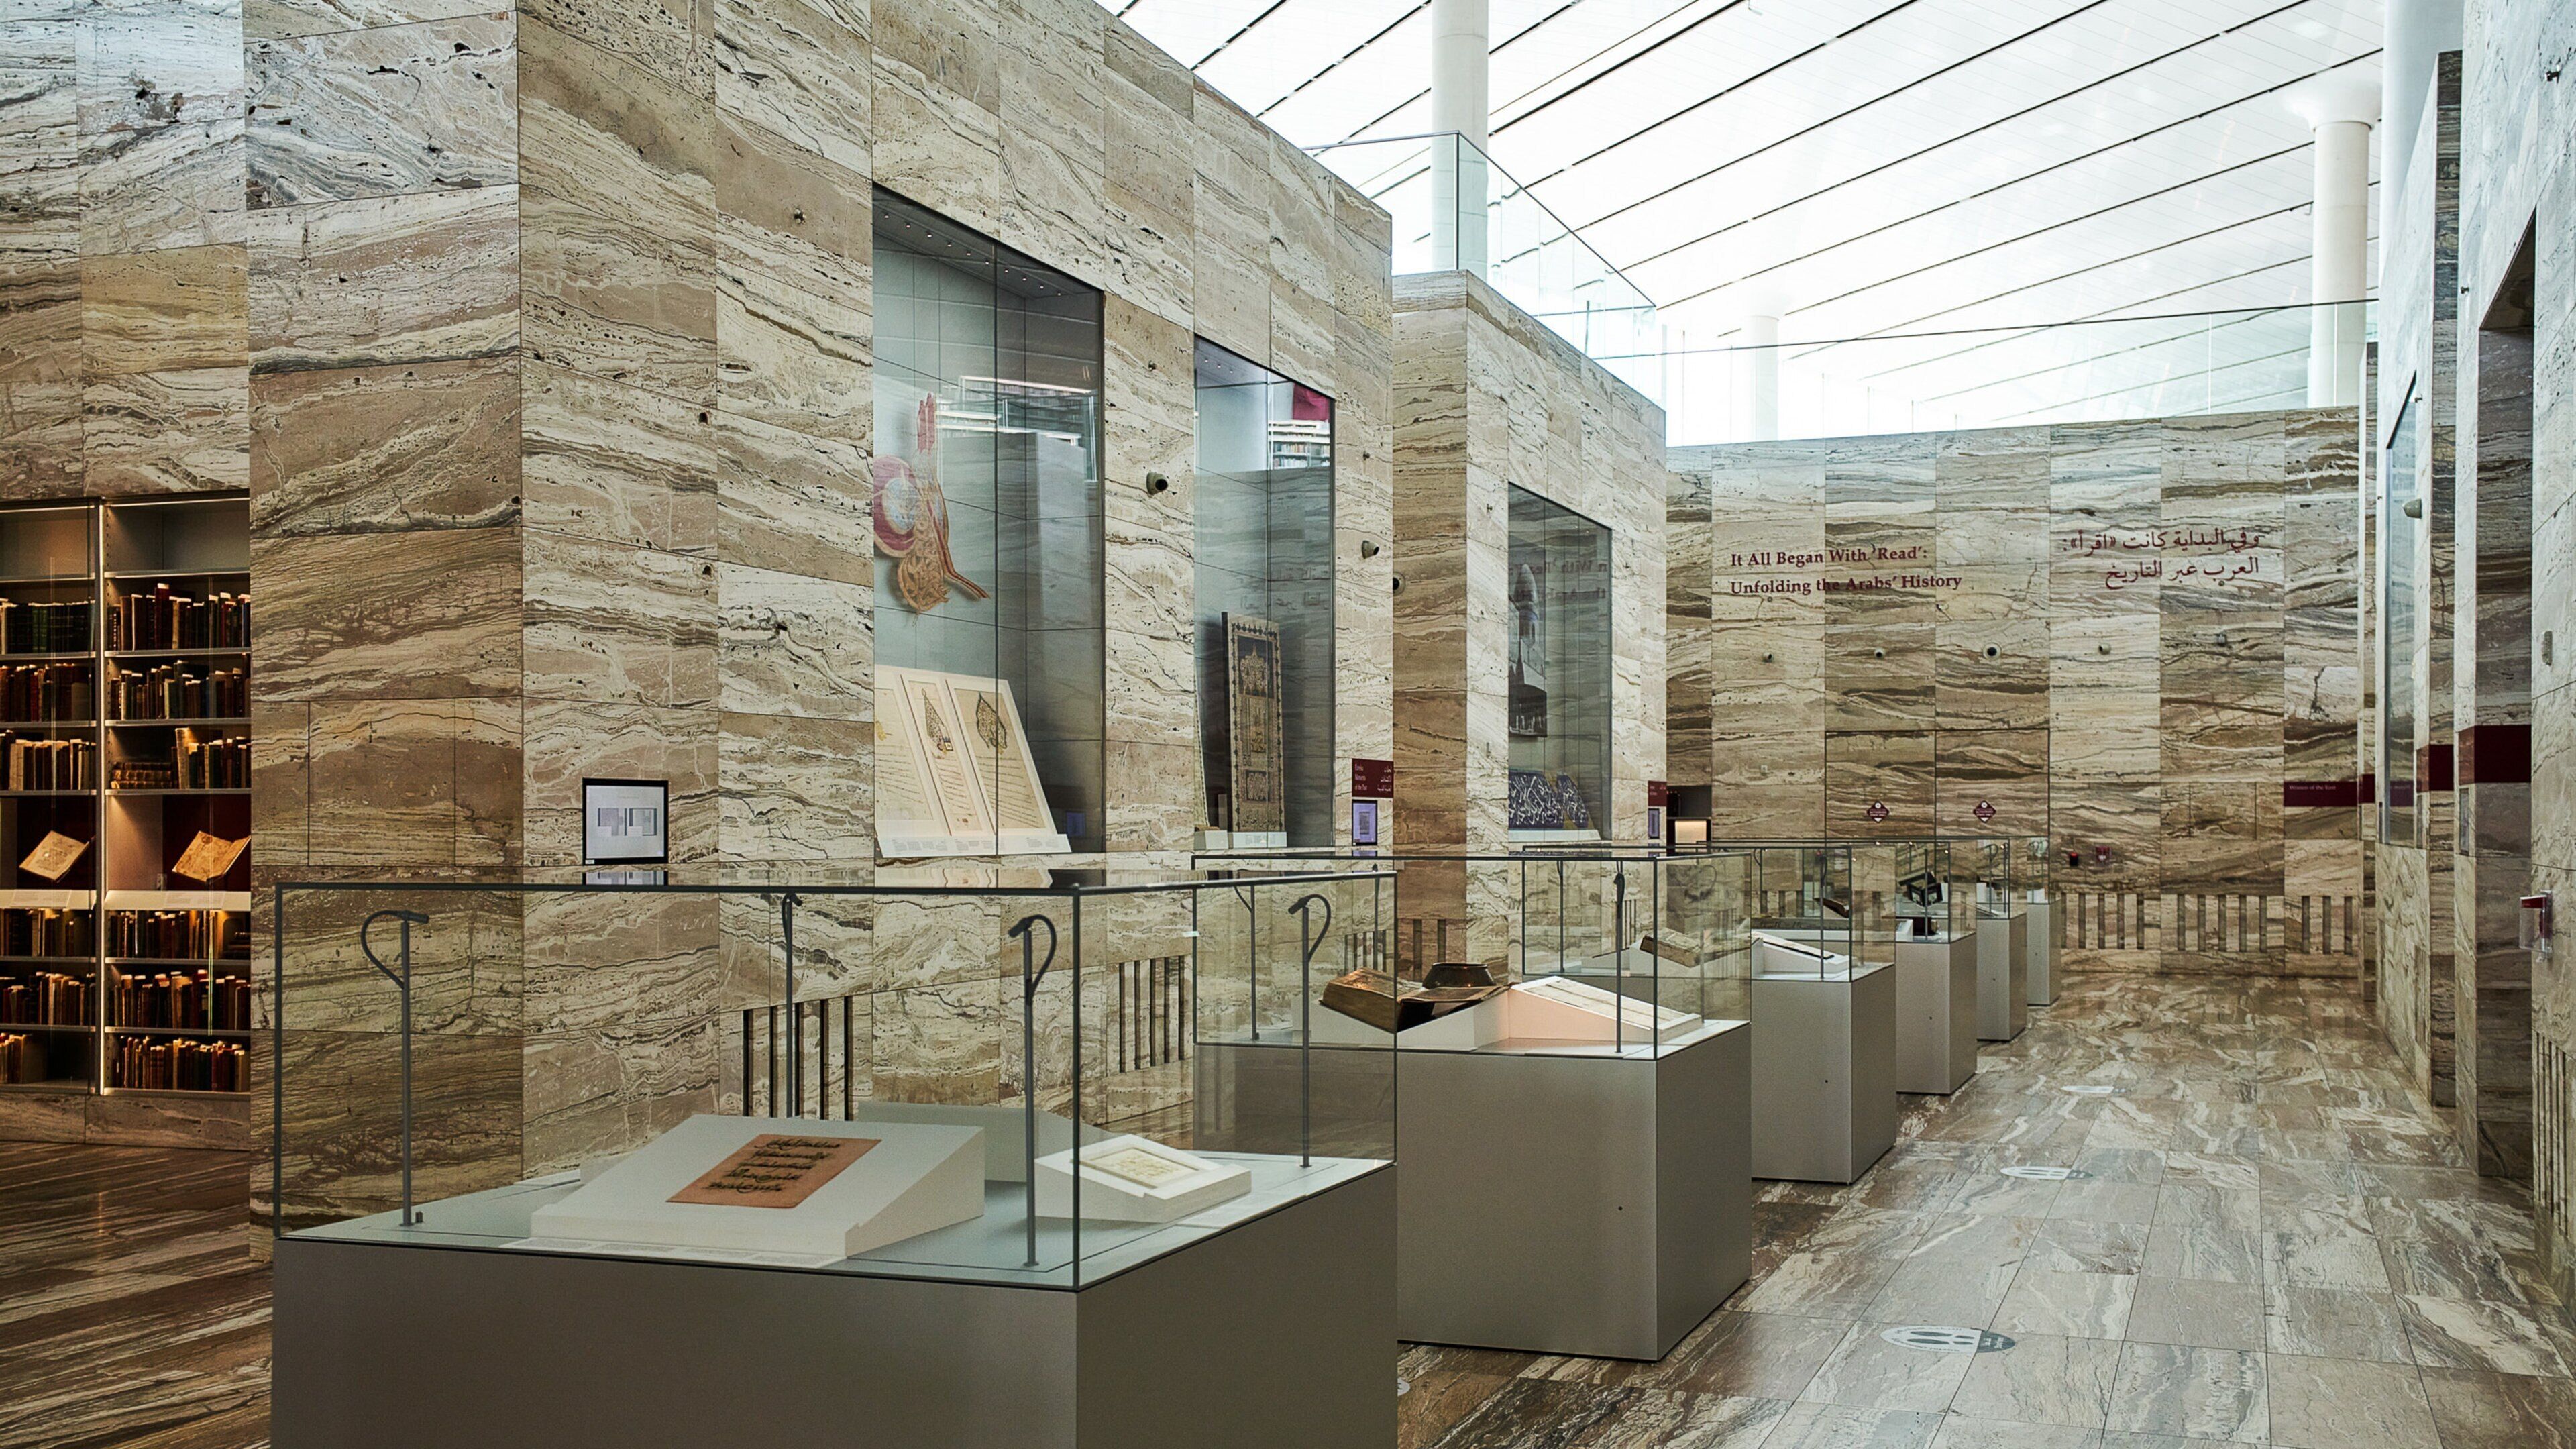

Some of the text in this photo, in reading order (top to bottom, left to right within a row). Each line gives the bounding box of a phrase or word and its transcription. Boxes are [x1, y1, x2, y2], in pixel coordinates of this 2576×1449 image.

[2123, 531, 2168, 549] كانت
[2174, 528, 2224, 551] البداية
[1731, 553, 1743, 566] It
[1747, 552, 1771, 566] All
[1776, 551, 1824, 568] Began
[1829, 548, 1868, 562] With
[2105, 555, 2259, 590] العرب عبر التاريخ
[1731, 574, 1963, 596] Unfolding the Arabs' History
